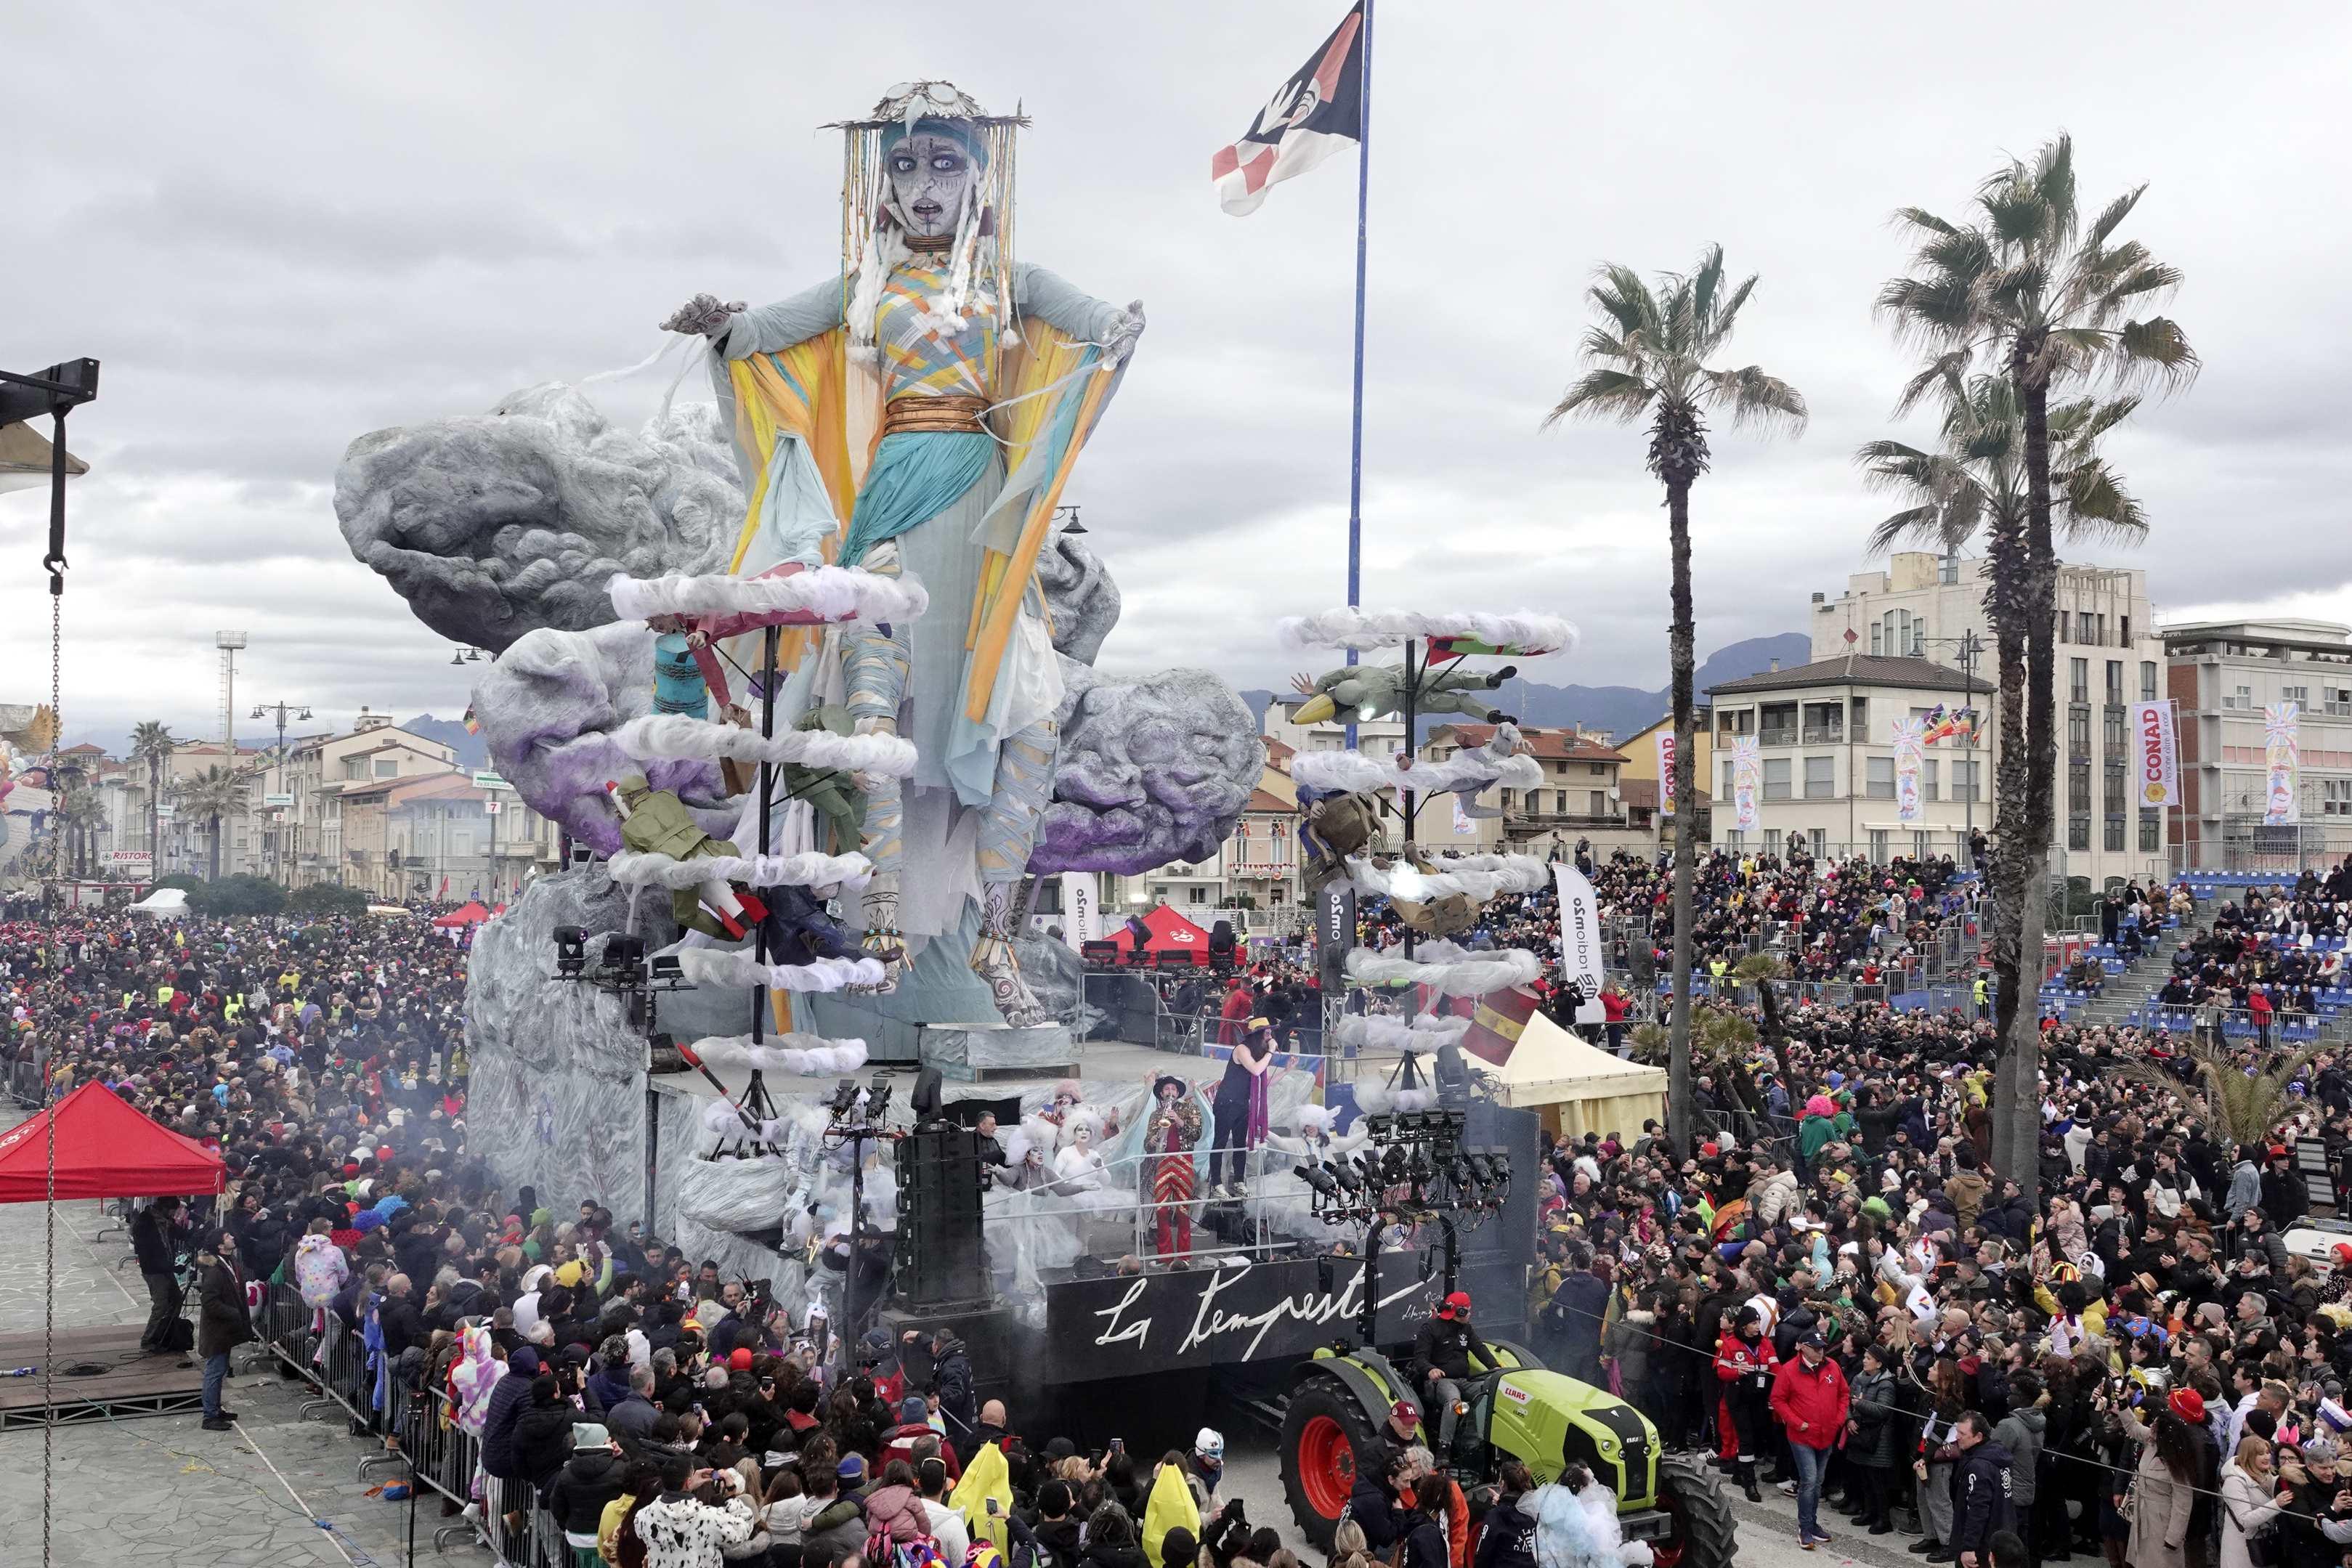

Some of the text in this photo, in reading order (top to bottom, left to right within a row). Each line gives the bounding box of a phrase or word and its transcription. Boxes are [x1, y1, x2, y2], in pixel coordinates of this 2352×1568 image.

[2142, 709, 2162, 781] CONAD
[490, 803, 497, 812] 7
[1093, 1277, 1152, 1350] La
[1504, 1387, 1527, 1400] CLAAS
